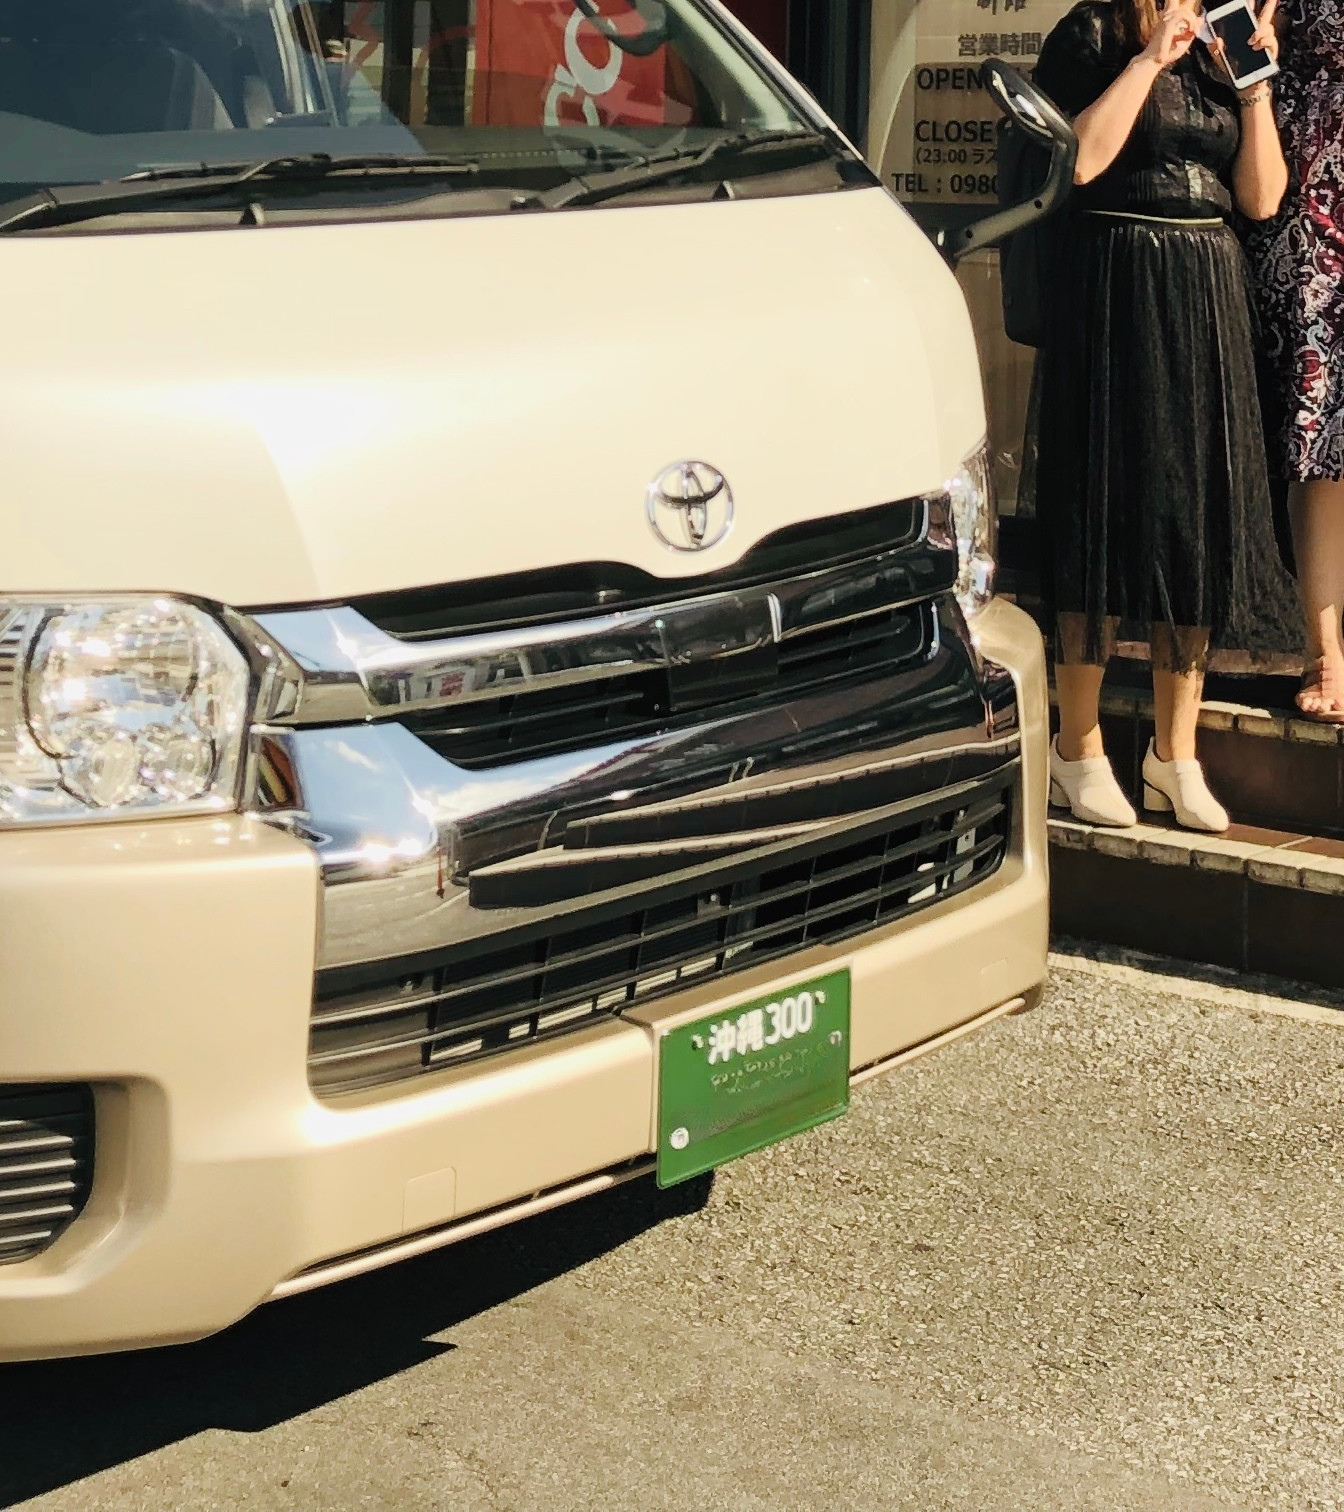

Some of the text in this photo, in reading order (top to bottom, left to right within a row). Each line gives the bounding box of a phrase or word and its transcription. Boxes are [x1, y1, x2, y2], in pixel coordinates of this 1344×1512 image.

[957, 32, 1043, 57] 営業時間
[917, 67, 984, 91] OPEN
[914, 119, 993, 143] CLOSE
